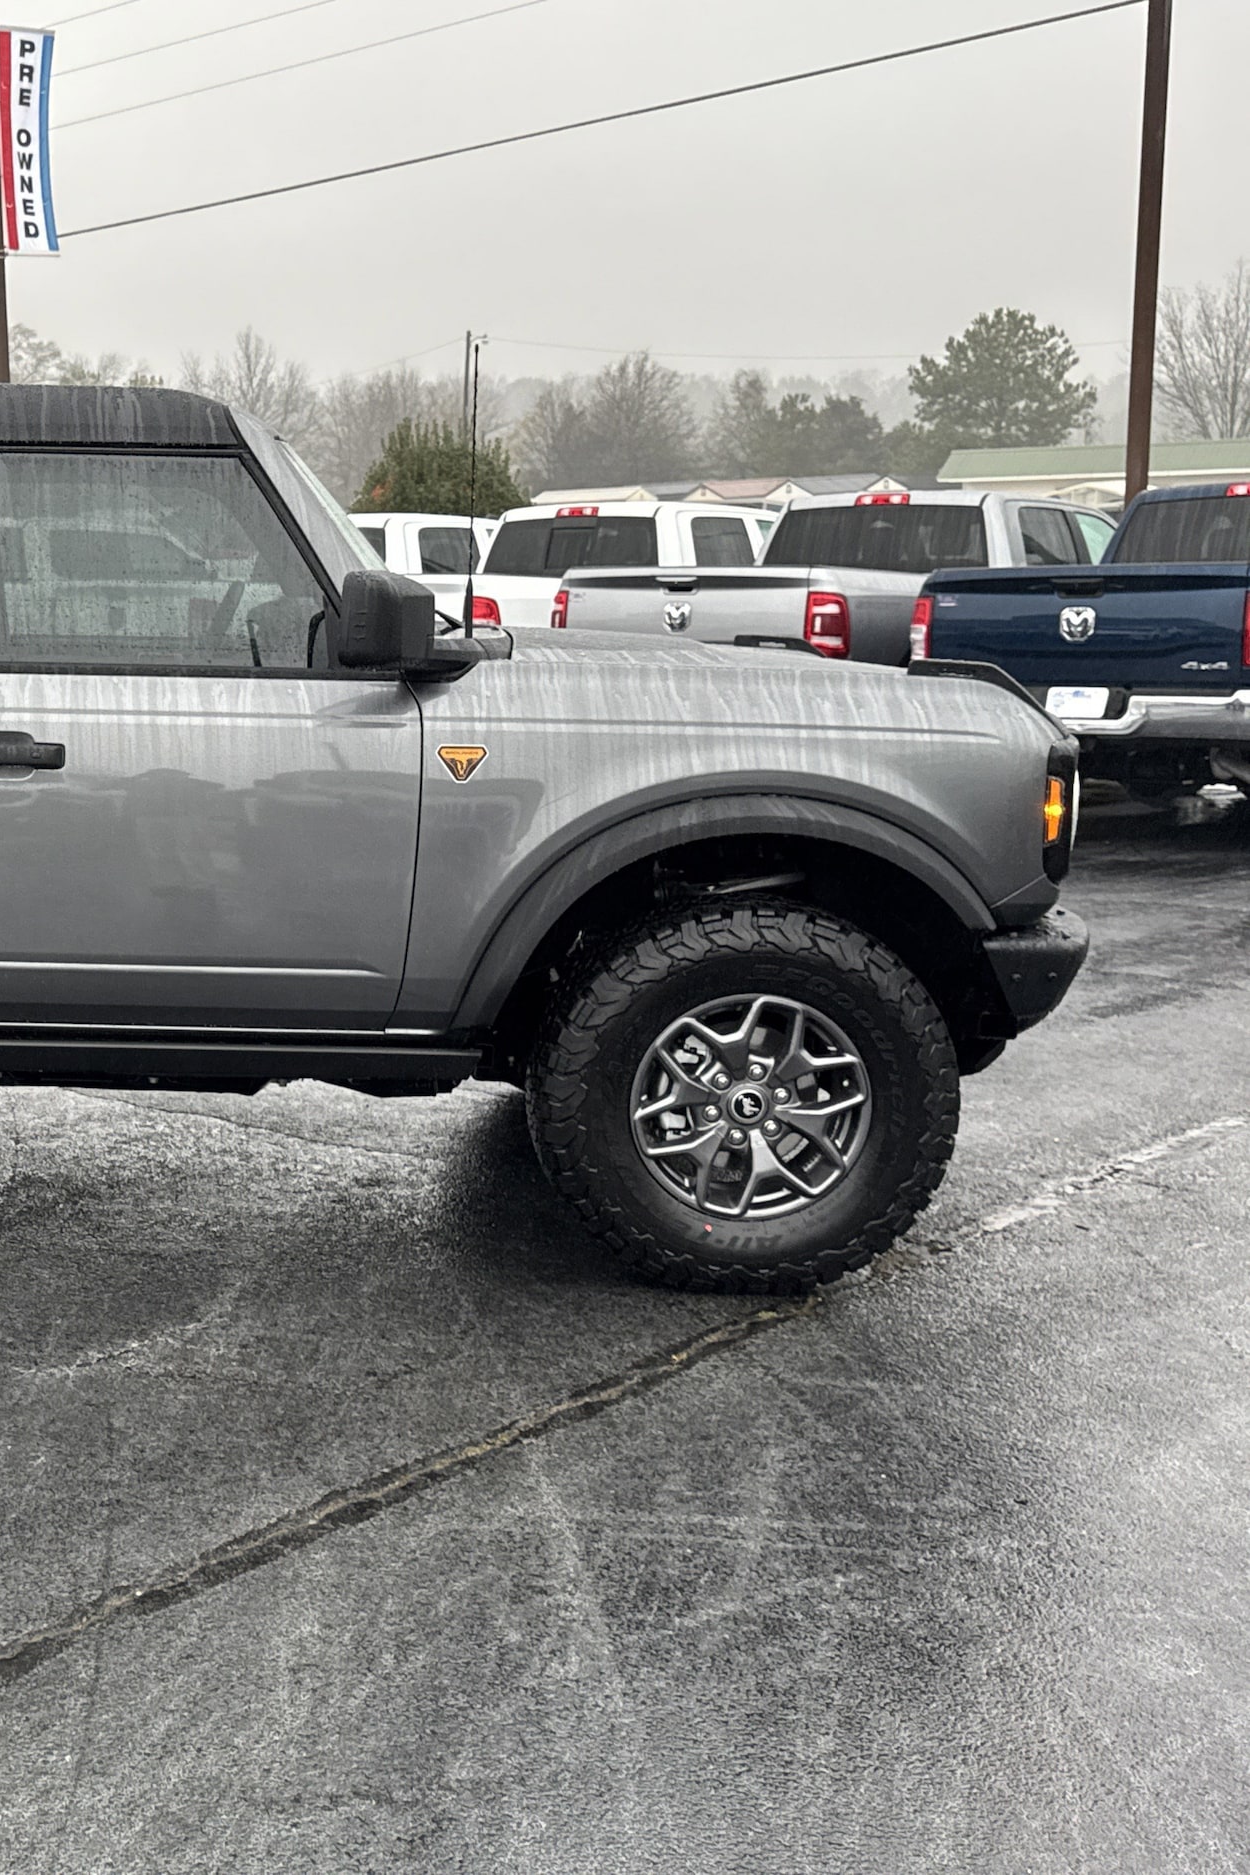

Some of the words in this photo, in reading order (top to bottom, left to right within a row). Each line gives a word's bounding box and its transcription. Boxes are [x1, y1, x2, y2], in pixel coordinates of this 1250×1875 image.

[18, 39, 36, 107] PRE
[16, 128, 40, 239] OWNED
[1180, 660, 1230, 671] 4x4
